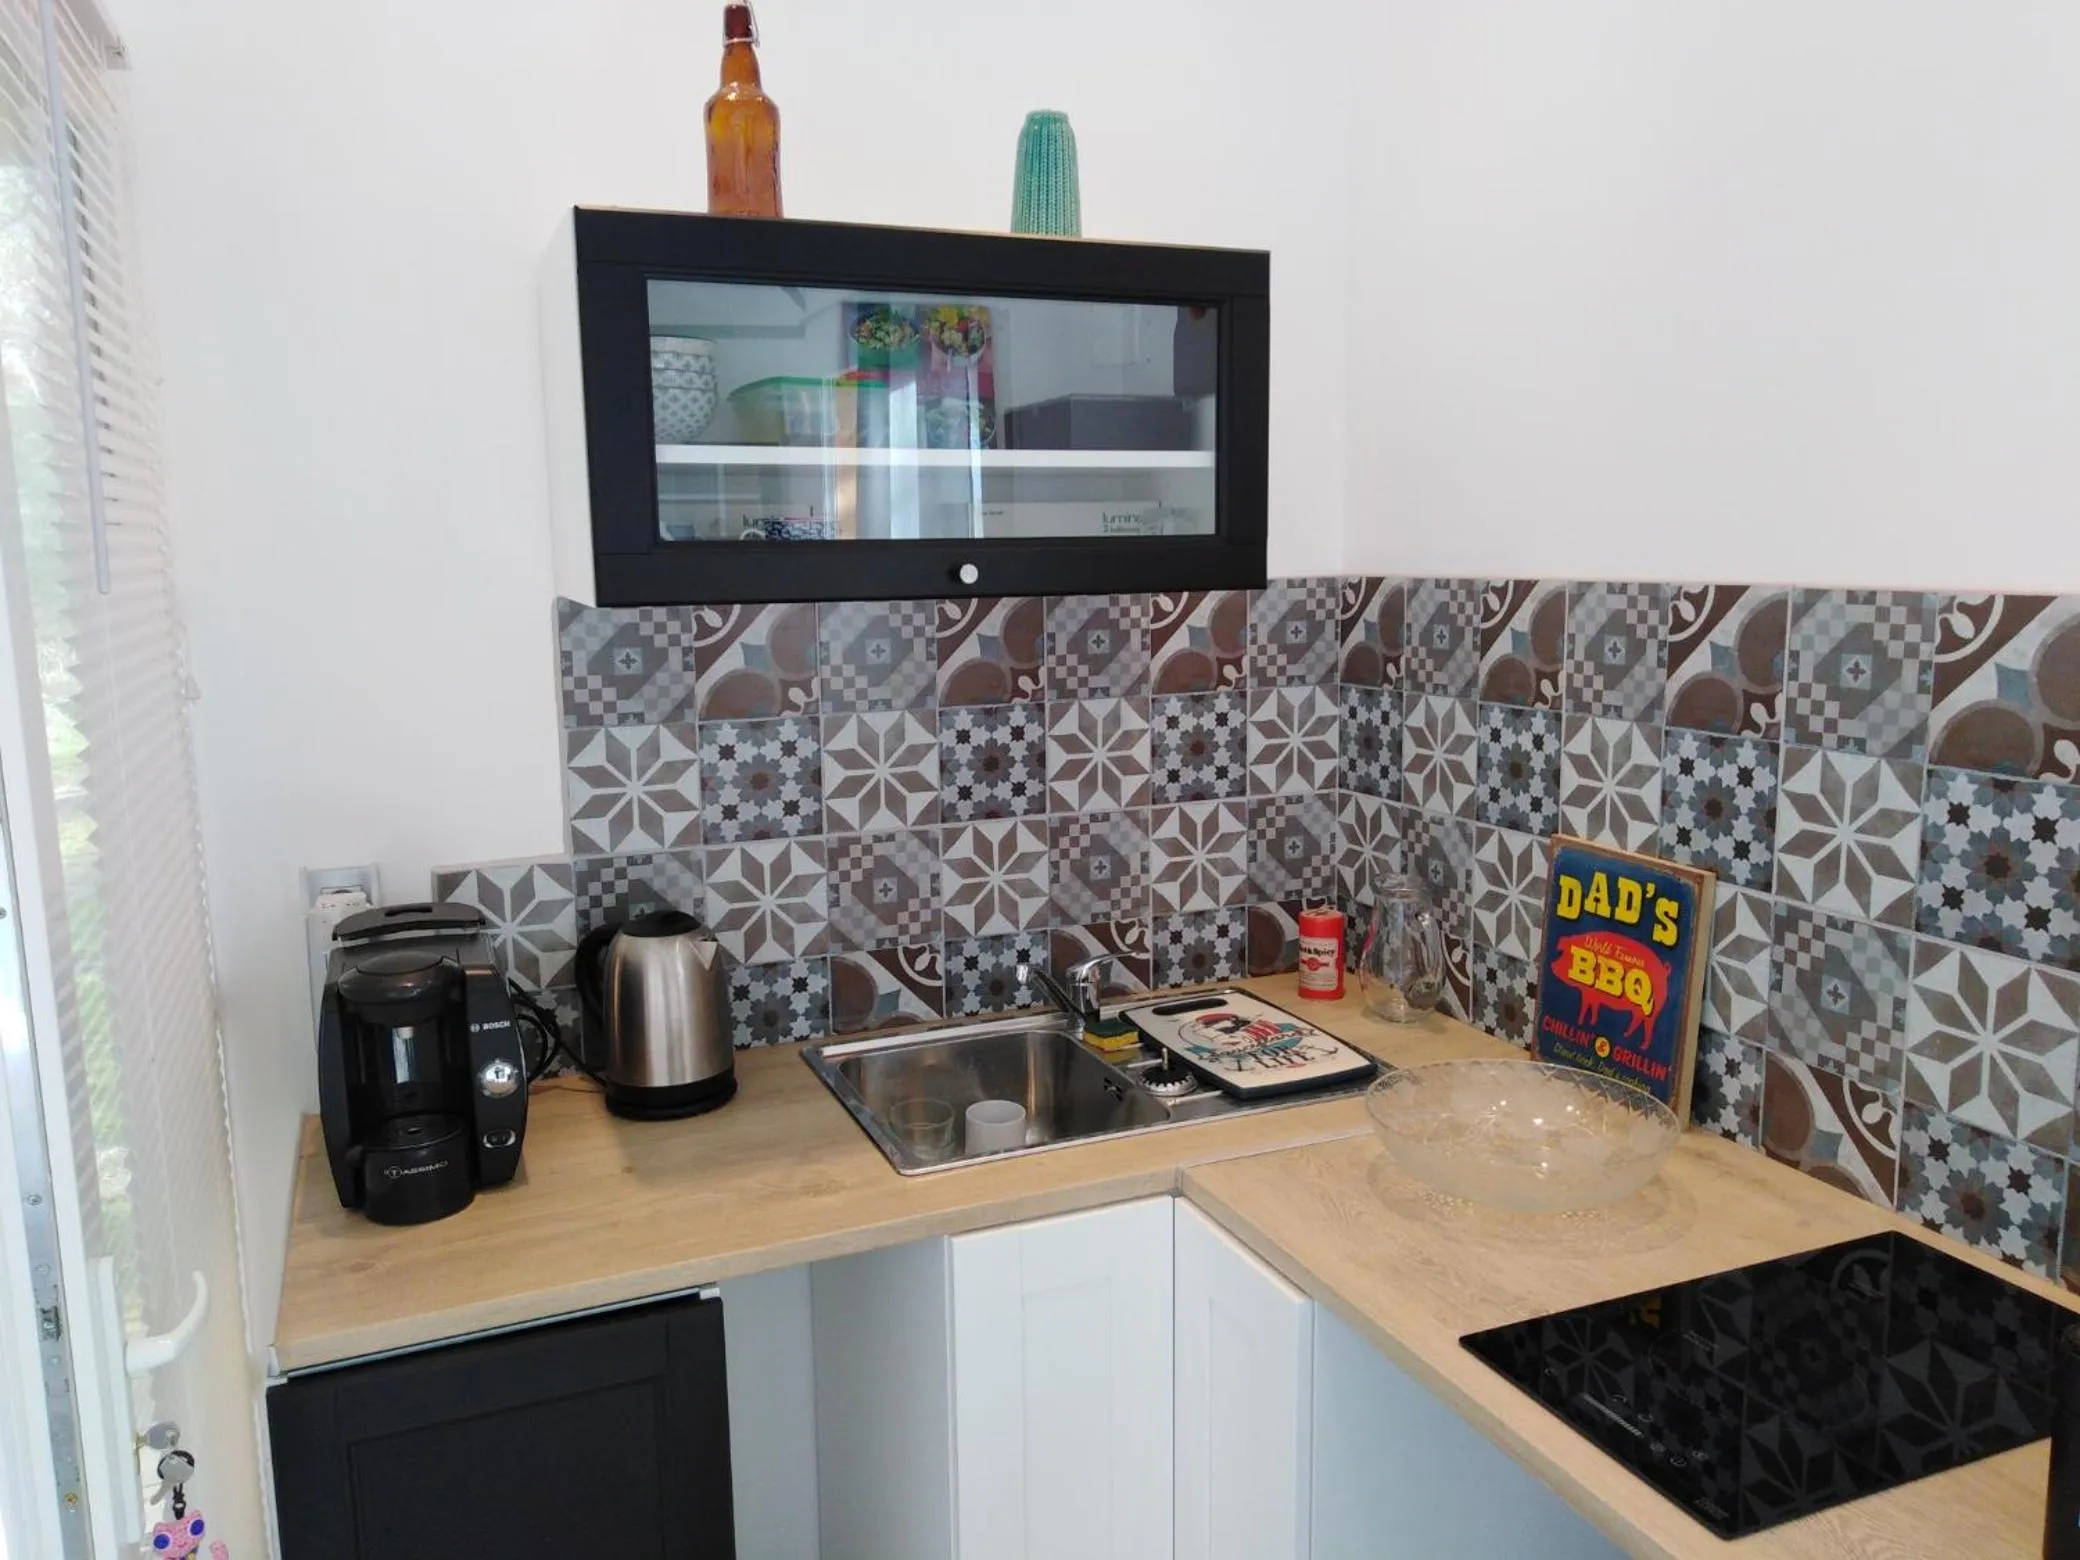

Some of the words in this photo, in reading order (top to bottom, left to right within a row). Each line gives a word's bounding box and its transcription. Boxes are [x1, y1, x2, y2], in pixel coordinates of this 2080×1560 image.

[1557, 872, 1679, 946] DAD'S
[1313, 948, 1335, 957] Spicy
[1568, 945, 1653, 1016] BBQ
[483, 1020, 511, 1030] BOSCH
[1543, 1015, 1595, 1048] CHILLIN'
[1613, 1045, 1673, 1081] GRILLIN'
[386, 1160, 448, 1178] TASSIMO
